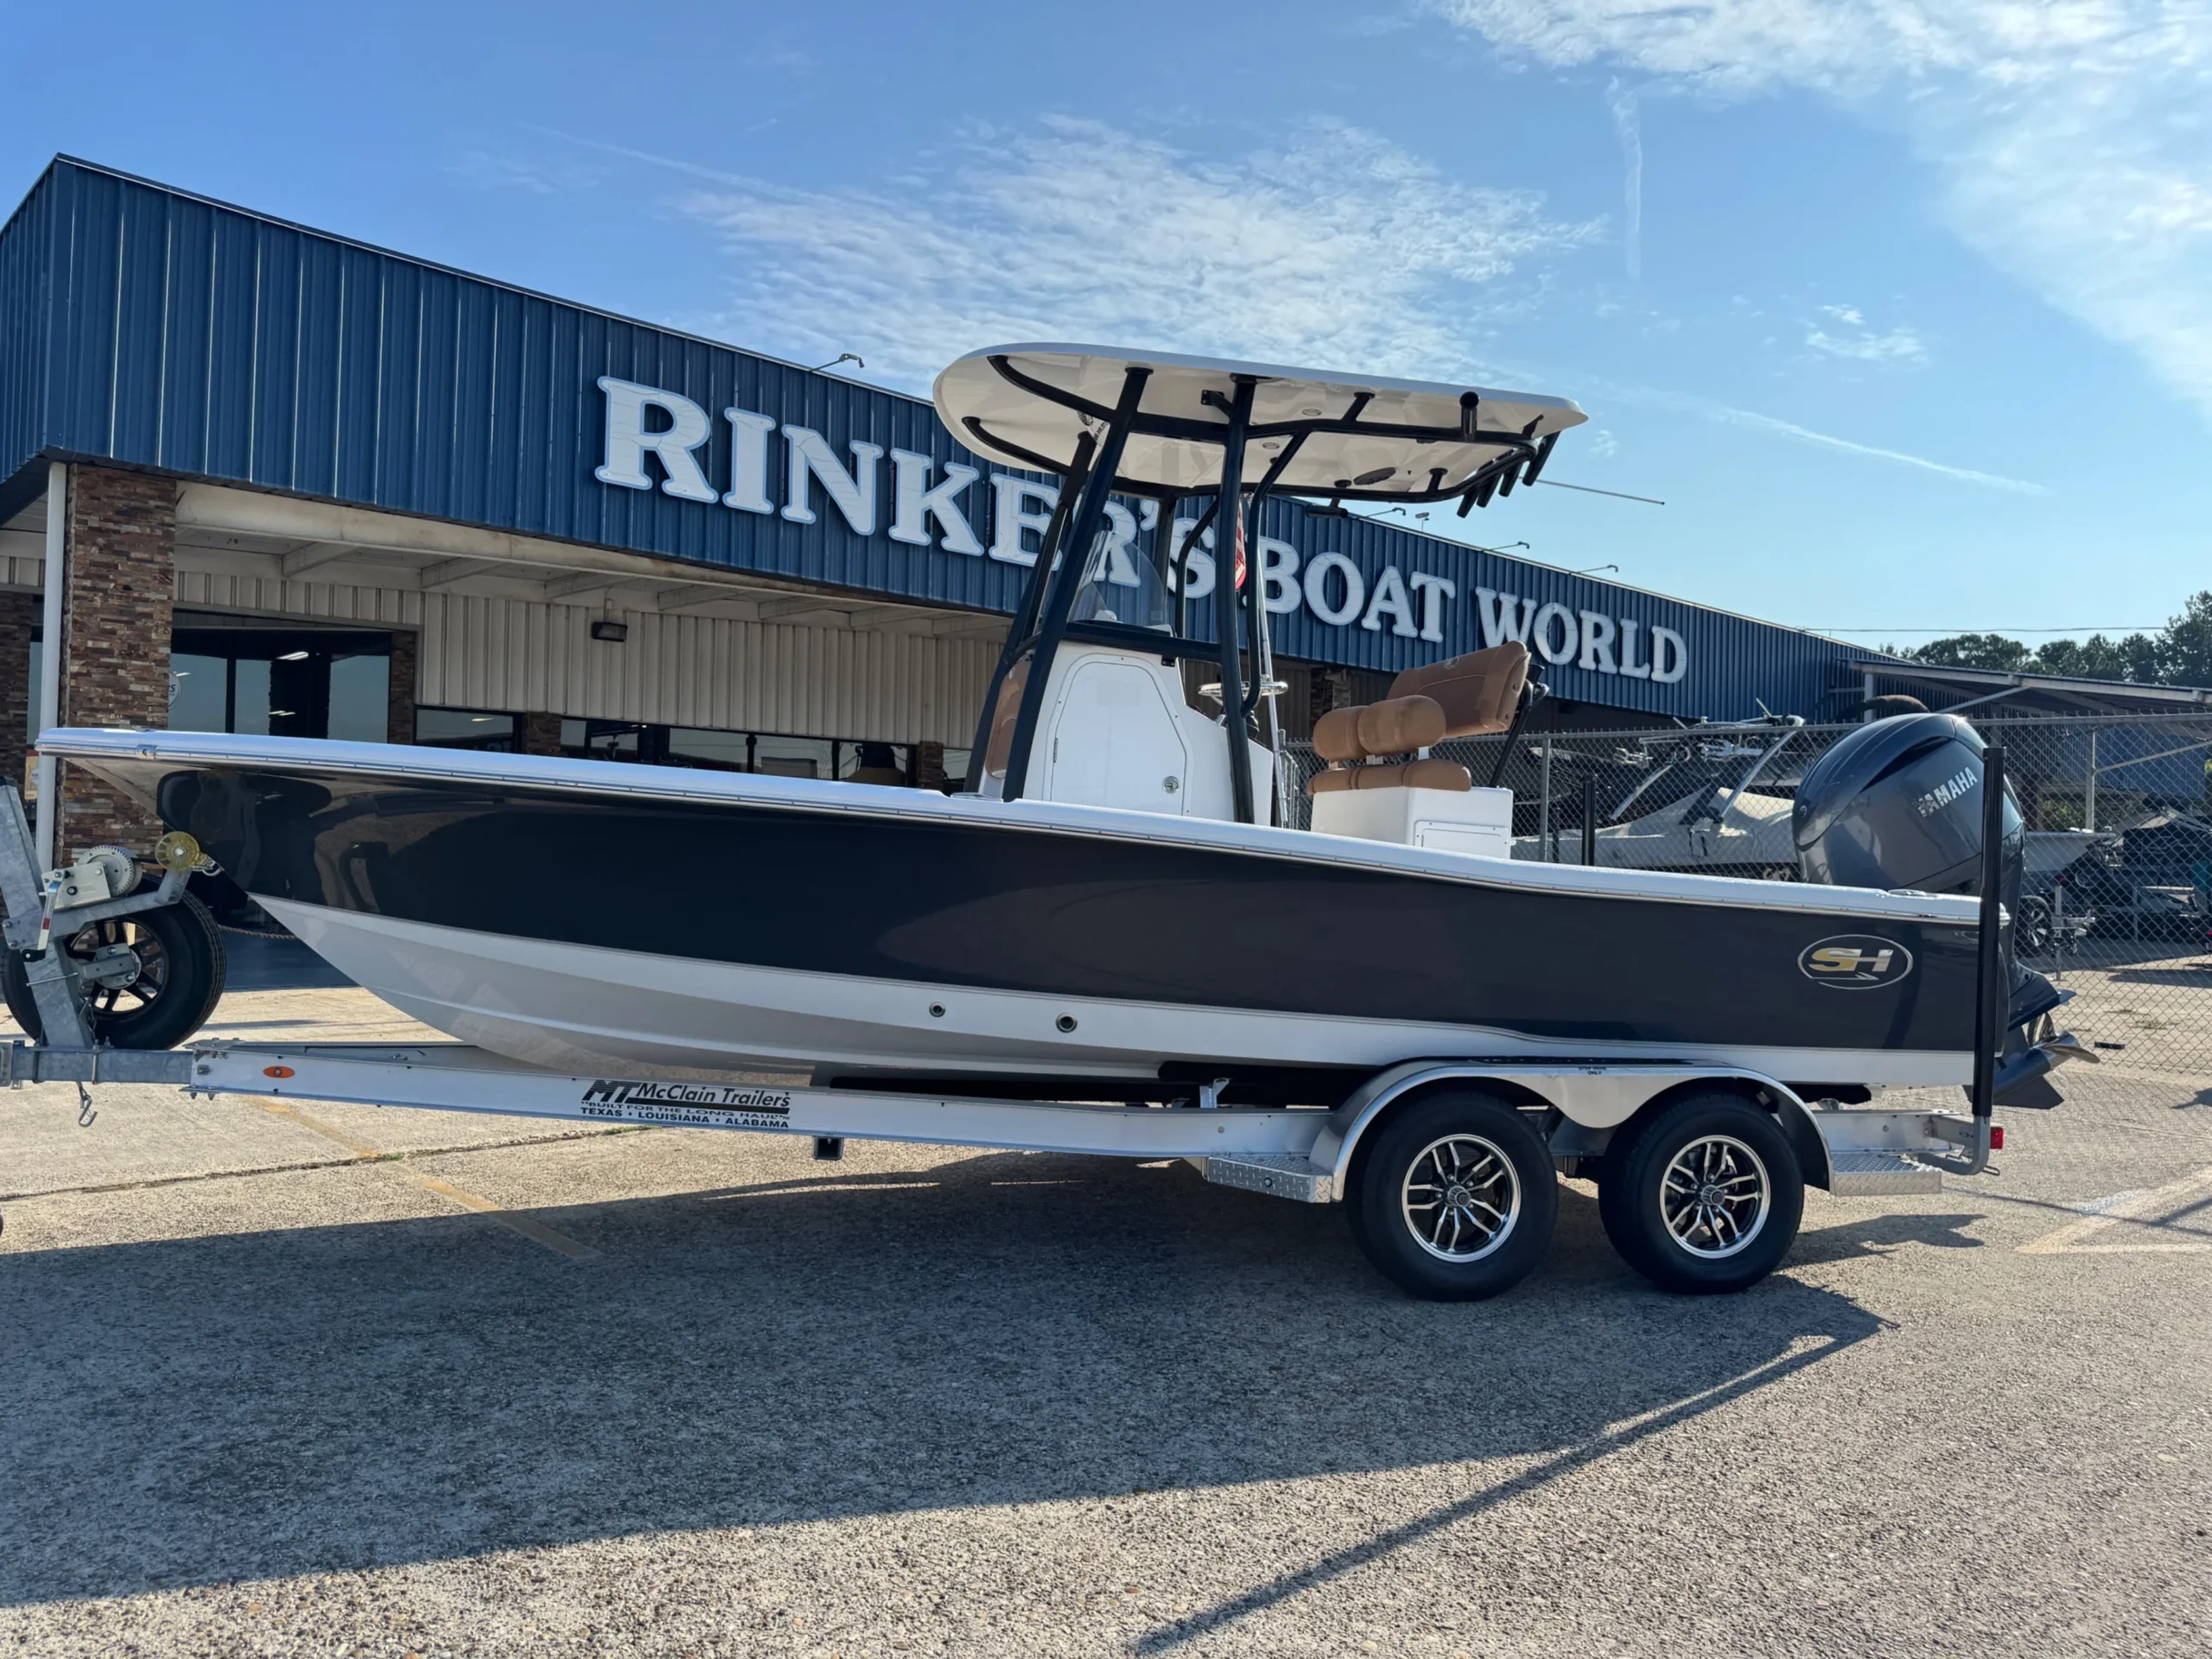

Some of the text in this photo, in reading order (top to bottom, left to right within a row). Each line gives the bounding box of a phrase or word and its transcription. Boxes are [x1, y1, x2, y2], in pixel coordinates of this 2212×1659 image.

[594, 376, 1688, 683] RINKER'S BOAT WORLD
[1917, 766, 1978, 818] YAMAHA
[582, 1079, 641, 1103] MT
[636, 1083, 715, 1103] McClain
[581, 1107, 789, 1128] TEXAS LOUISIANA ALABAMA
